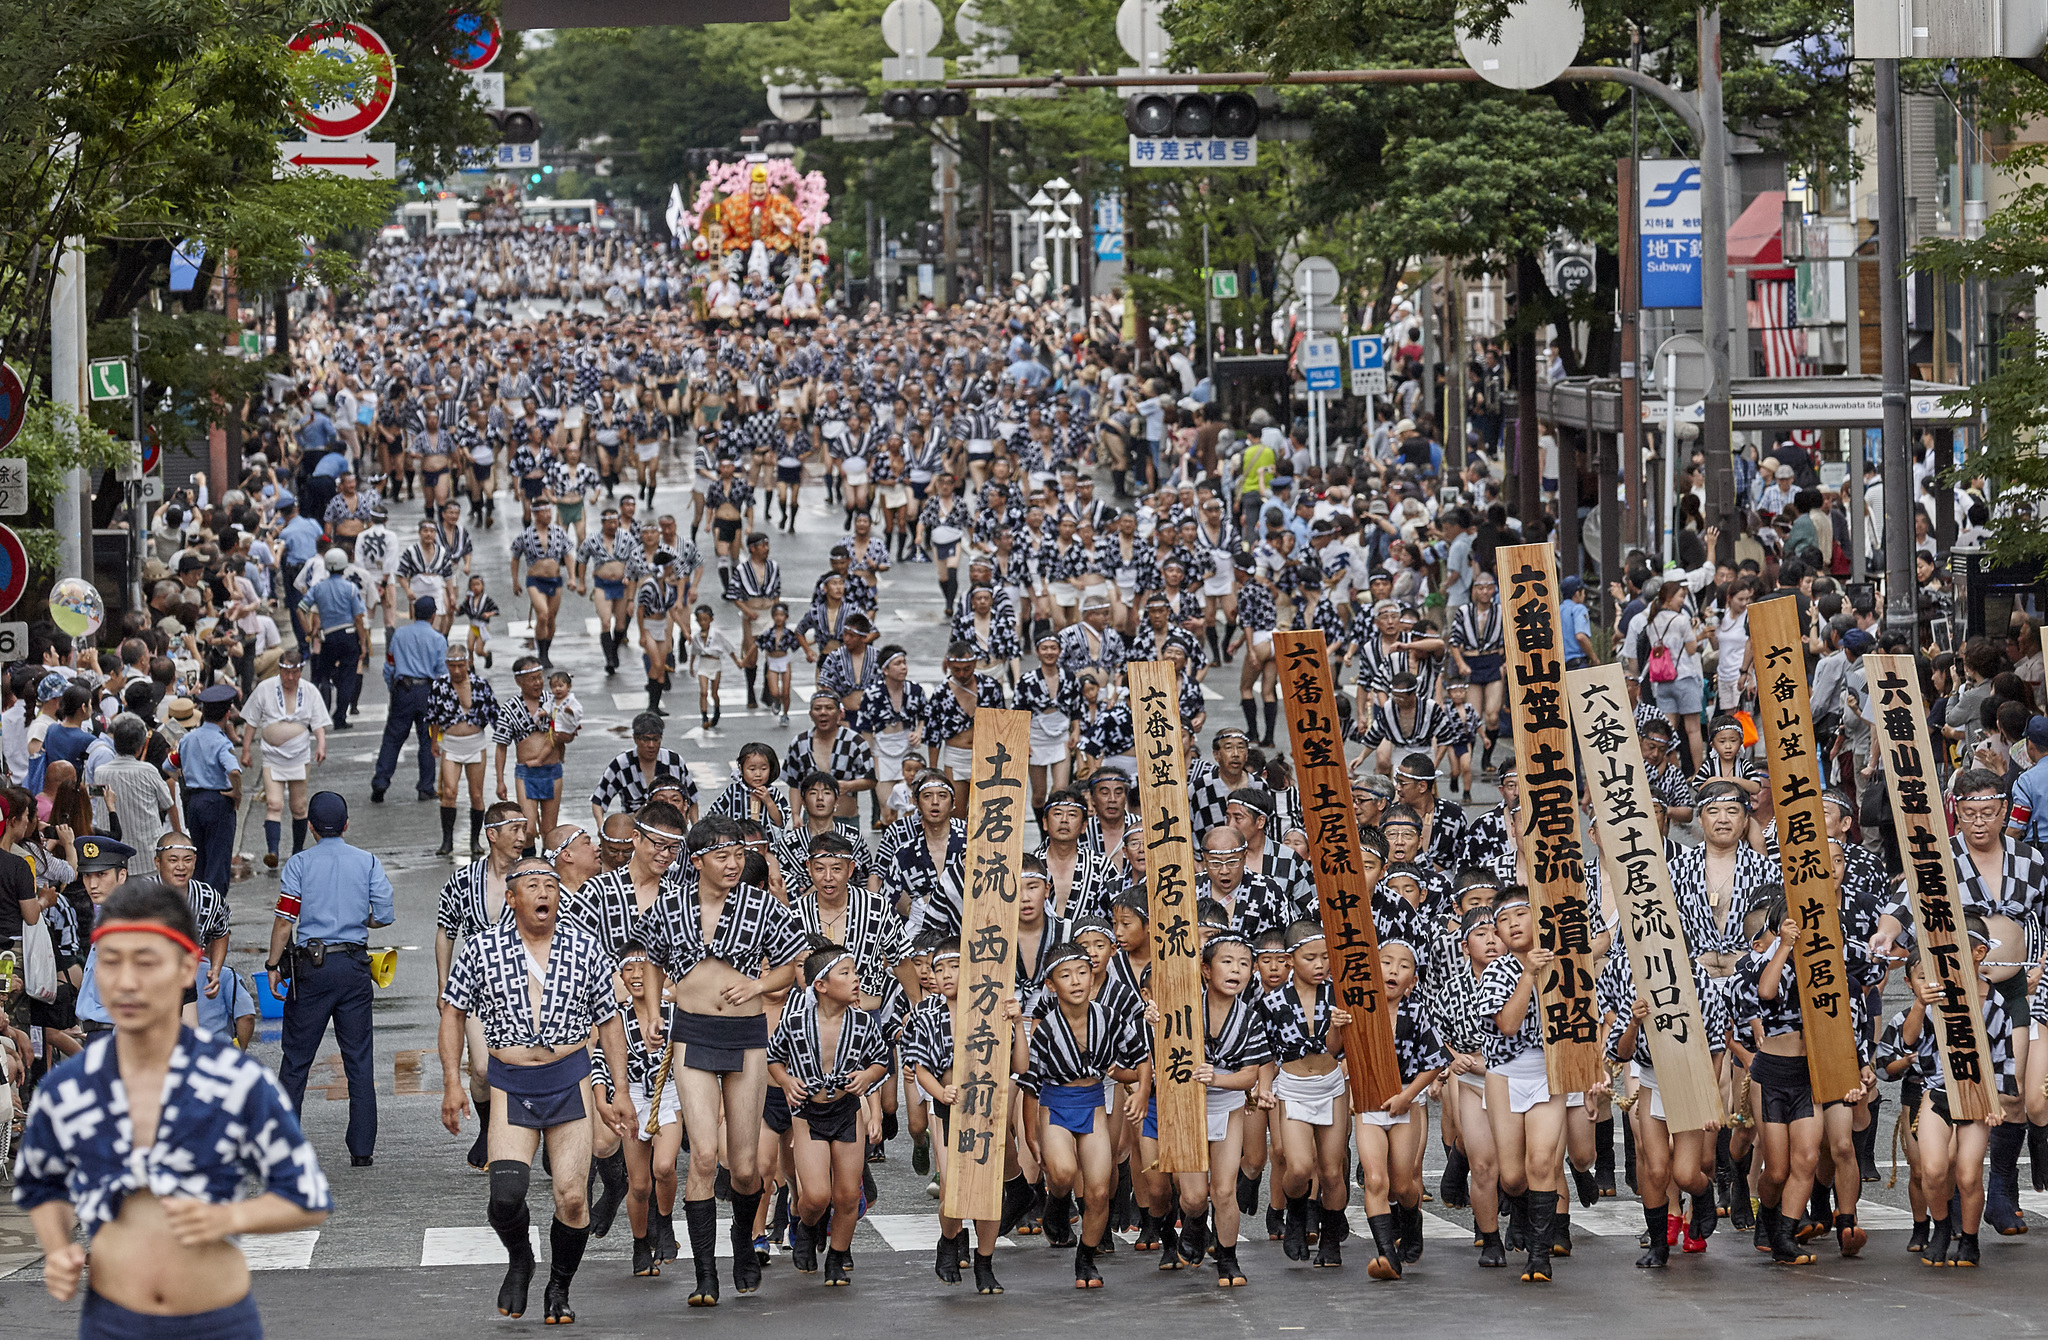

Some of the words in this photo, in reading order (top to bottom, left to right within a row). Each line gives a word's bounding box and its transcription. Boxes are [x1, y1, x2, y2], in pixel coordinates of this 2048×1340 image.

[1136, 140, 1250, 161] 時差式信号
[1562, 266, 1589, 278] DVD
[1647, 261, 1692, 274] Subway
[1310, 369, 1336, 379] POLICE
[1358, 340, 1378, 367] P
[1792, 401, 1866, 411] Nakasukawabata
[0, 631, 15, 653] 6
[1509, 564, 1568, 733] 六番山笠
[1139, 686, 1178, 788] 六番山笠
[1284, 642, 1340, 769] 六番山笠
[1764, 646, 1807, 761] 六番山笠
[1877, 671, 1932, 814] 六番山笠
[970, 742, 1022, 903] 土居流
[1310, 783, 1358, 876] 土居流
[1523, 743, 1585, 884] 土居流
[1779, 774, 1830, 886] 土居流
[1147, 807, 1196, 961] 土居流
[1907, 825, 1957, 933] 土居流
[1326, 889, 1379, 1013] 中土居町
[1799, 897, 1841, 1018] 片土居町
[958, 924, 1008, 1166] 西方寺前町
[1164, 1004, 1194, 1084] 川若
[1927, 944, 1981, 1084] 下土居町
